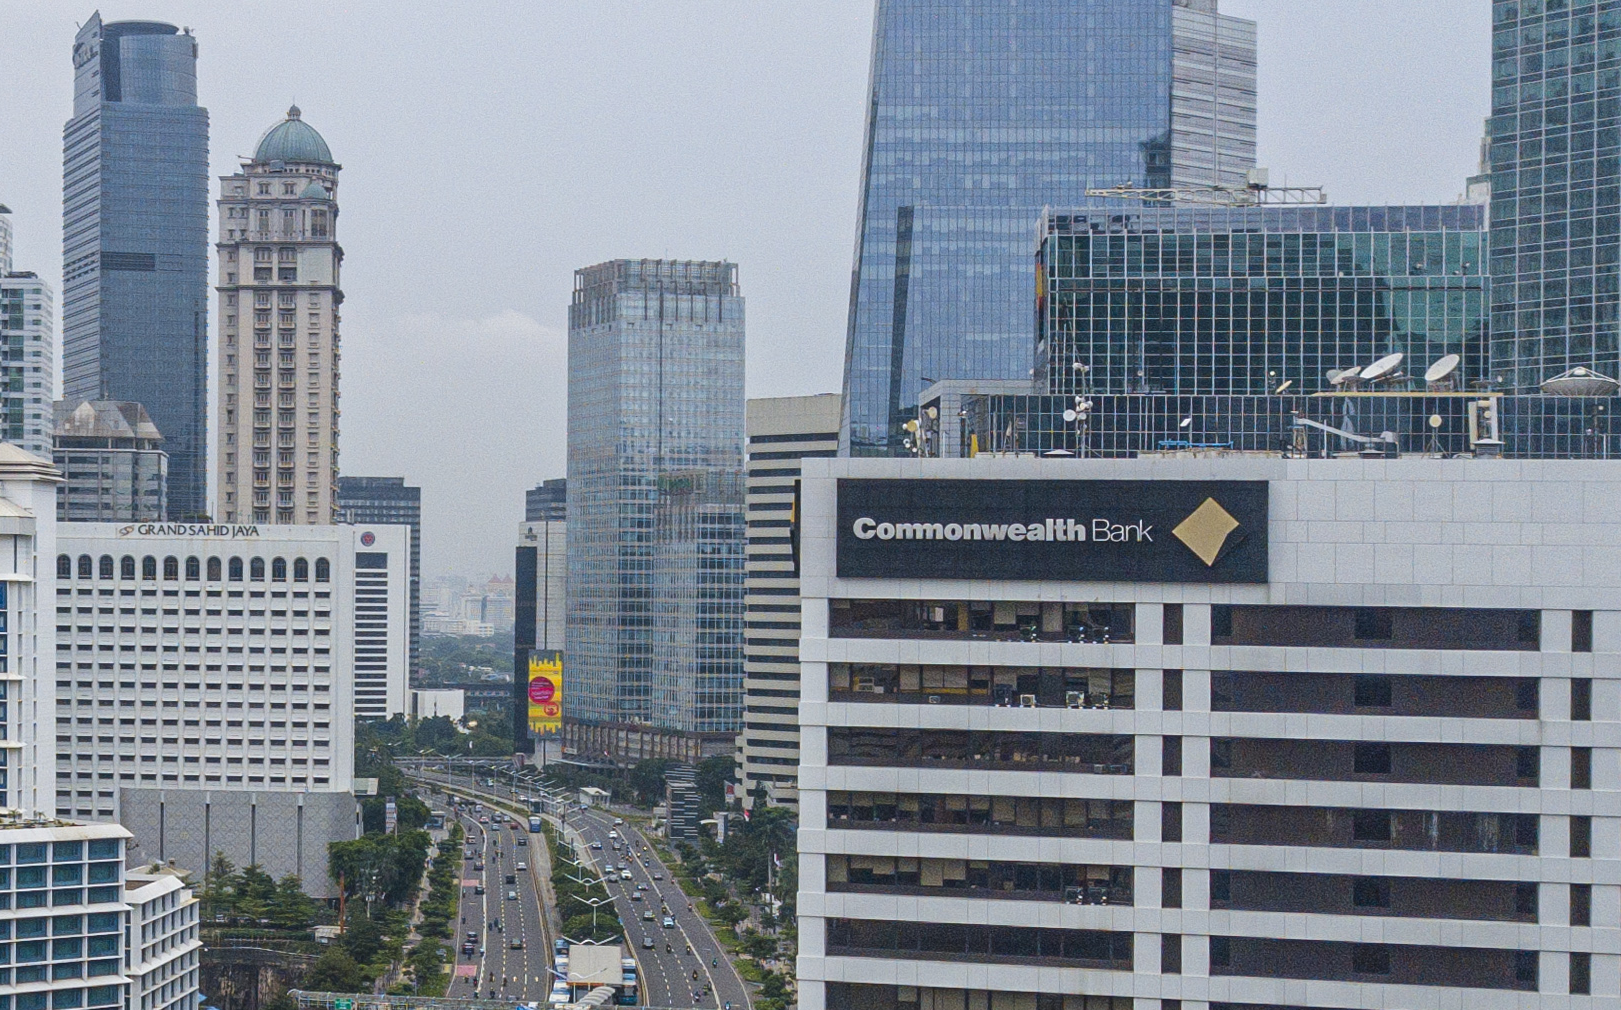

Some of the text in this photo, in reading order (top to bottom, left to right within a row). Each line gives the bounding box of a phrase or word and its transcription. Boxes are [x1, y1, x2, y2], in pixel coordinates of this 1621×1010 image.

[137, 524, 260, 538] GRAND SAHID JAYA
[852, 517, 1154, 543] Commonwealth Bank
